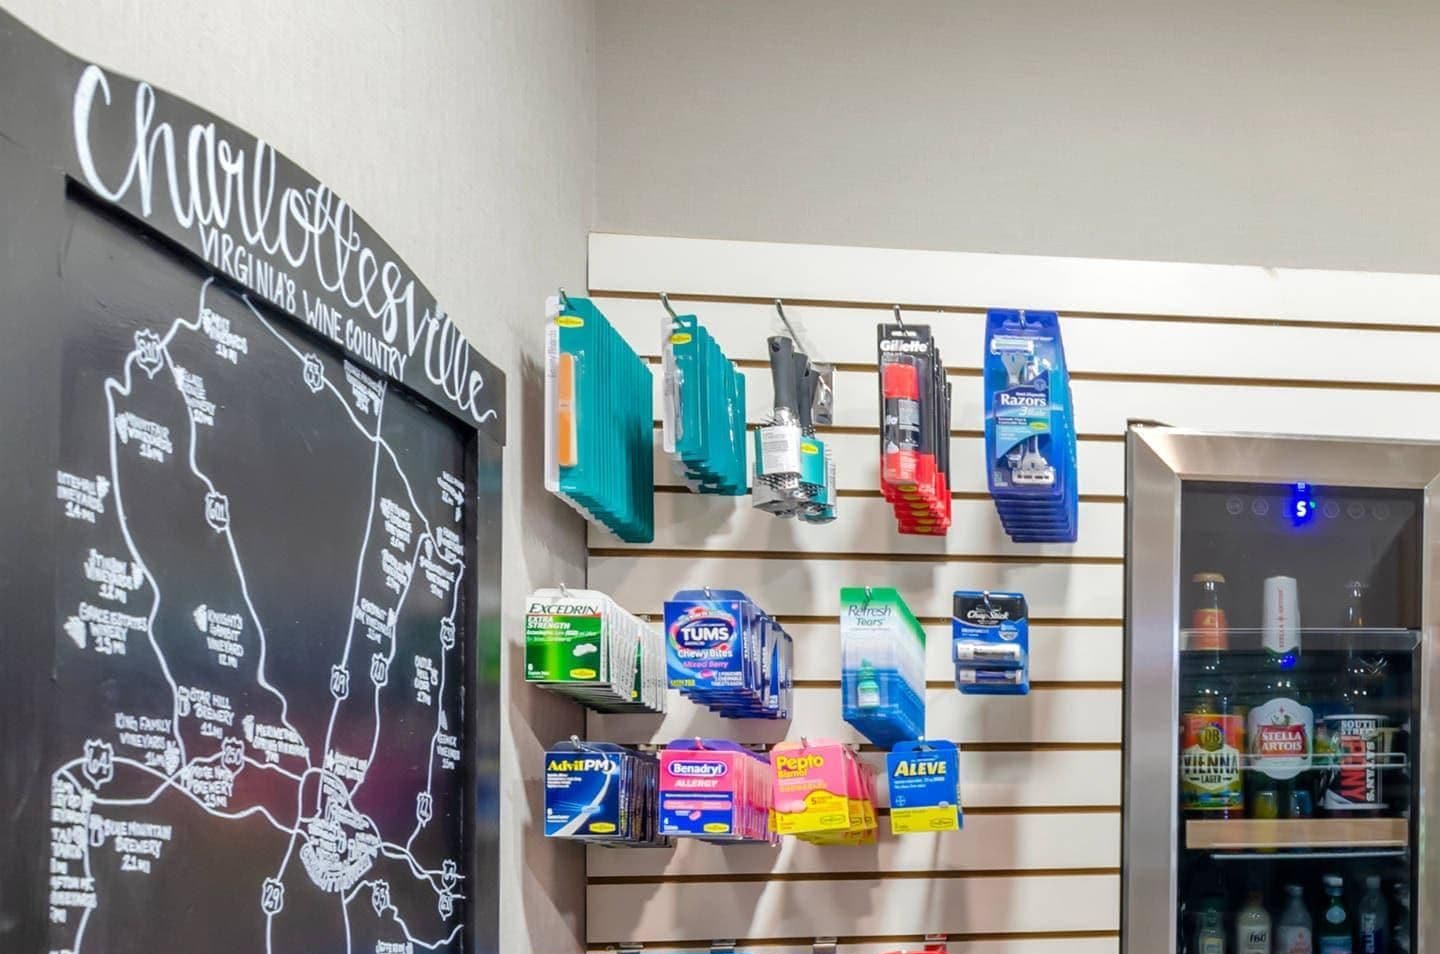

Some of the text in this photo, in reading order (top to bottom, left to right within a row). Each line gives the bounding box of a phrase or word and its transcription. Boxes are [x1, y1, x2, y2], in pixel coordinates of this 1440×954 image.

[73, 64, 498, 422] Charlottesville
[303, 290, 343, 344] WINE
[346, 319, 407, 382] COUNTRY
[880, 340, 929, 353] Gillette
[1000, 393, 1047, 406] Razors
[529, 603, 599, 614] EXCEDRIN
[848, 604, 892, 617] Refresh
[856, 616, 883, 626] Tears
[681, 627, 729, 641] TUMS
[1262, 731, 1301, 741] STELLA
[1262, 741, 1302, 751] ARTOIS
[547, 759, 610, 772] Advil PM
[672, 762, 722, 776] Benadryl
[776, 754, 824, 771] Pepto
[894, 761, 947, 777] ALEVE
[1184, 755, 1239, 775] VIENNA
[675, 779, 718, 788] ALLERGY
[1200, 775, 1222, 784] LAGER
[264, 886, 280, 911] 29
